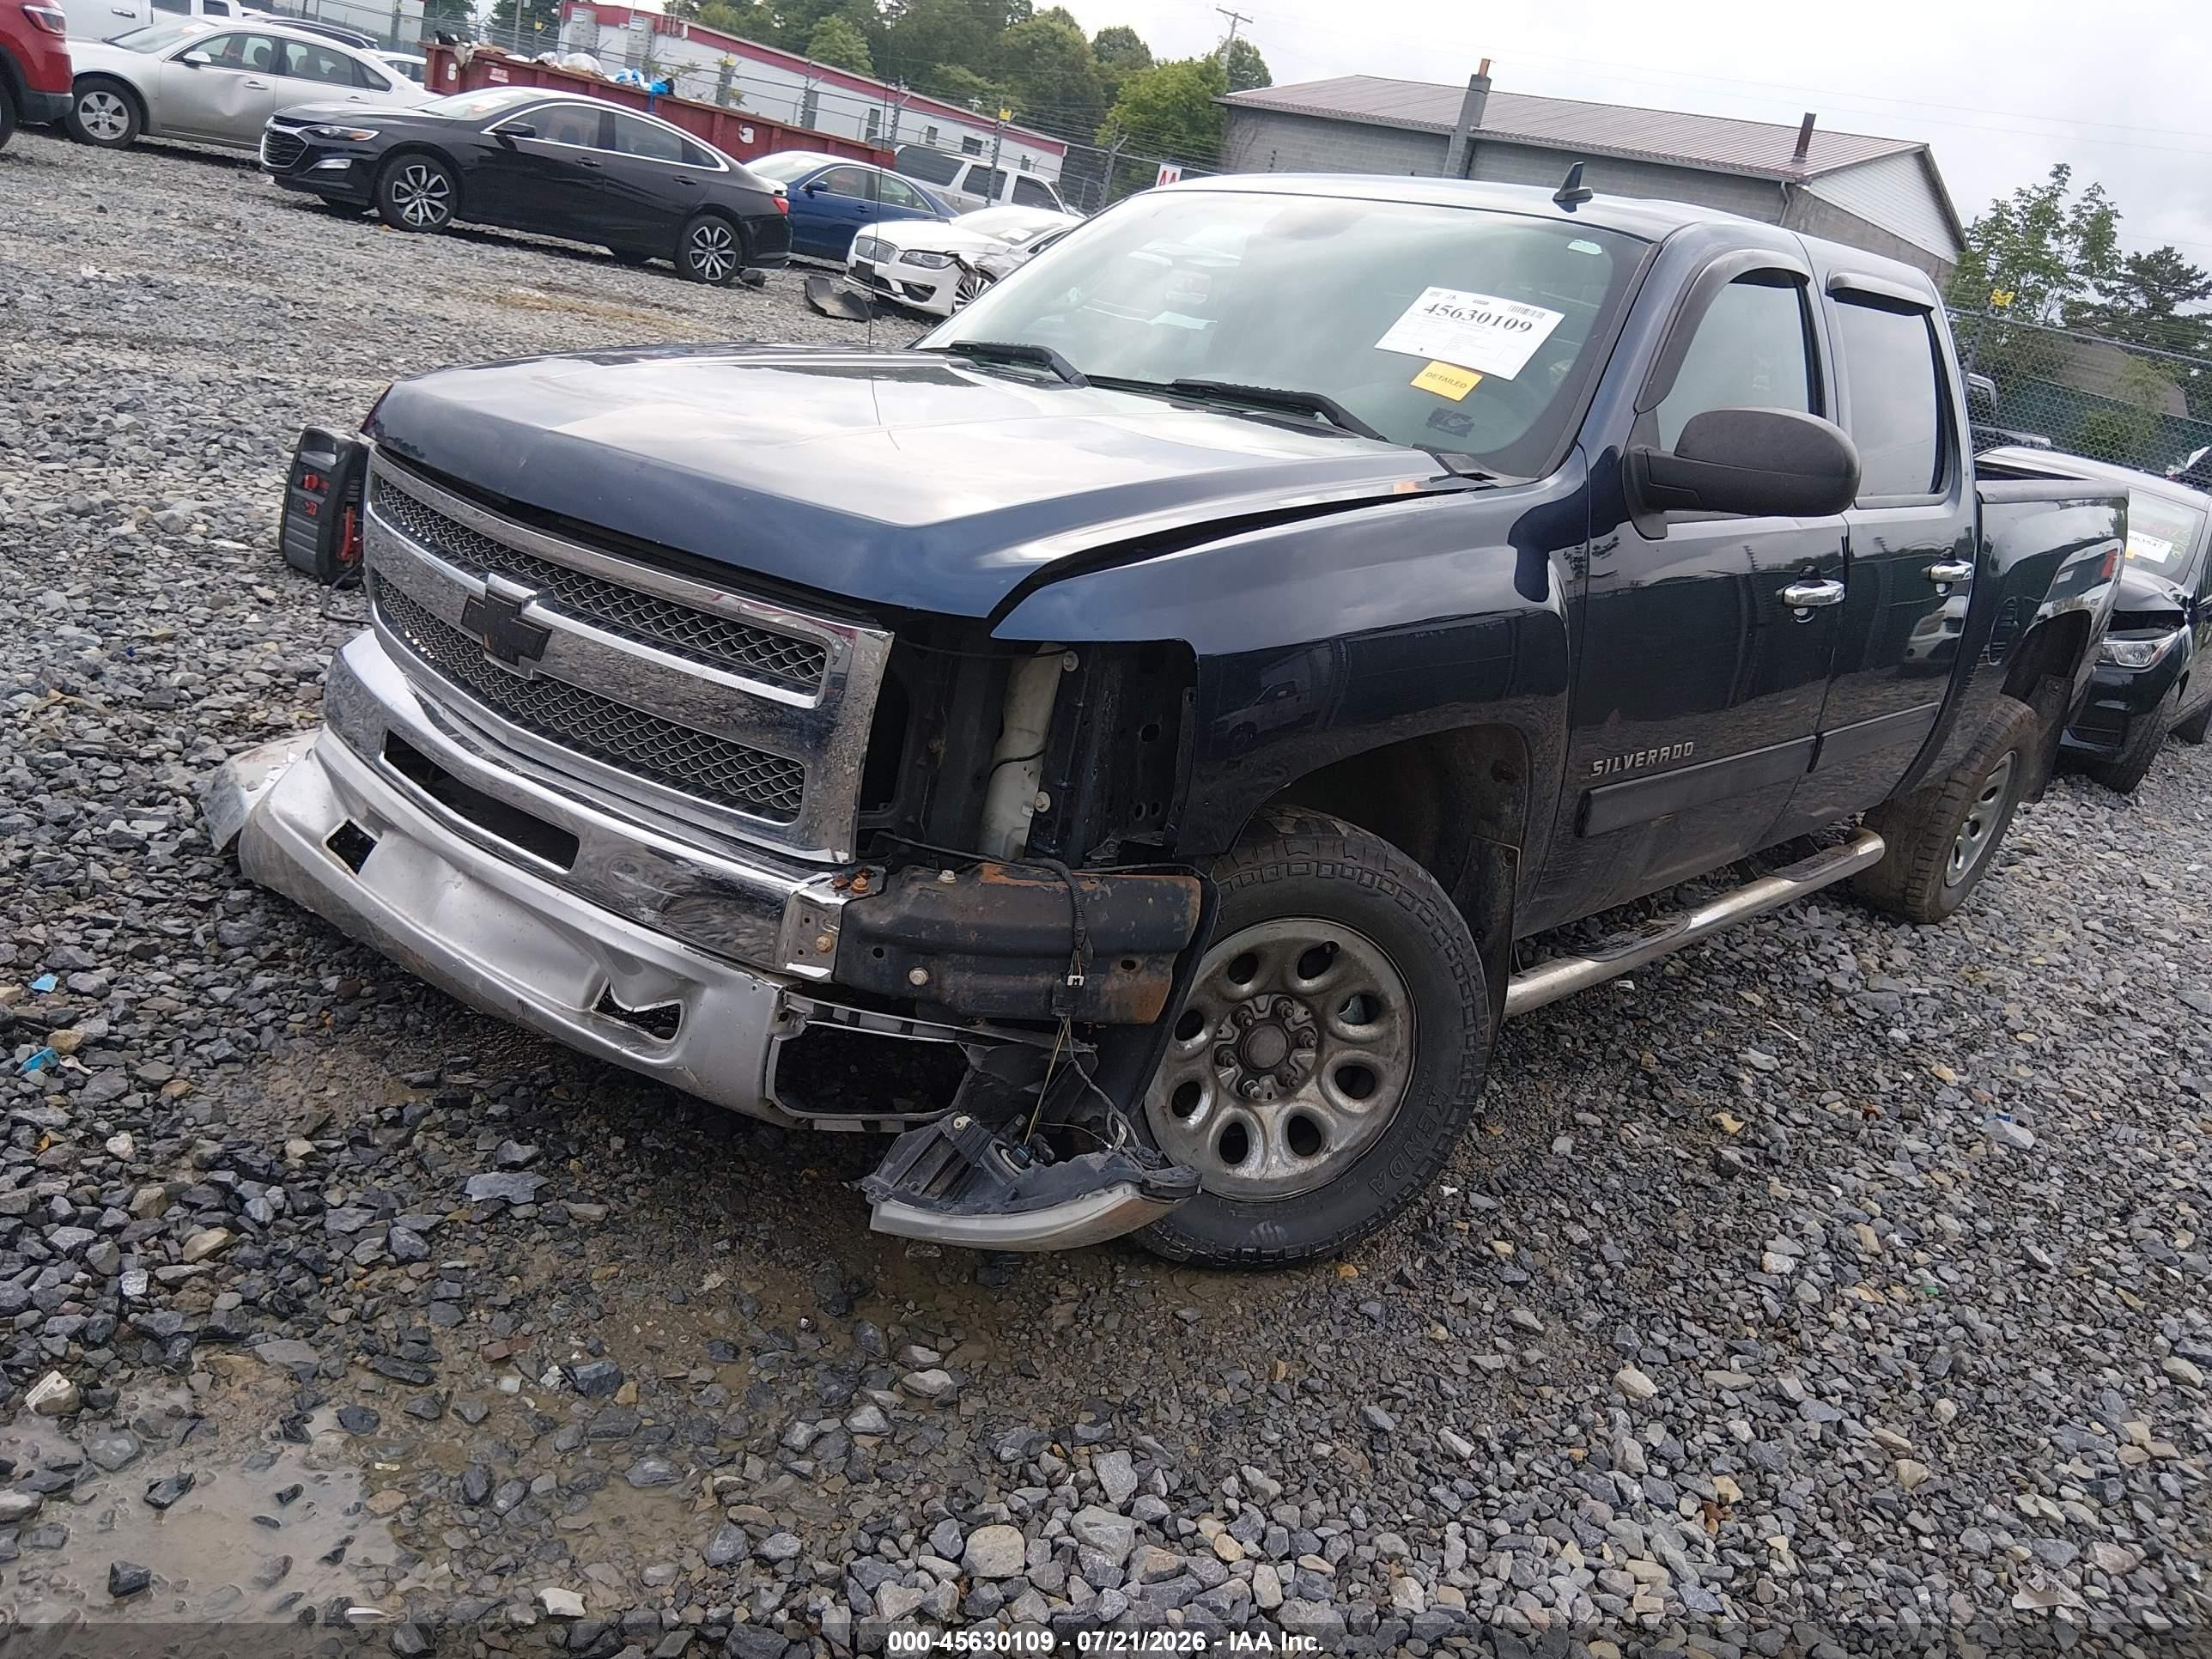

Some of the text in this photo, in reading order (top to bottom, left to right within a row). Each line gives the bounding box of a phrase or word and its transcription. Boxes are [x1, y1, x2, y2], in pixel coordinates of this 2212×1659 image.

[1423, 302, 1533, 333] 45630109
[1425, 371, 1468, 390] DETAILED
[1589, 741, 1694, 777] SILVERADO
[1368, 1085, 1449, 1196] KENDA
